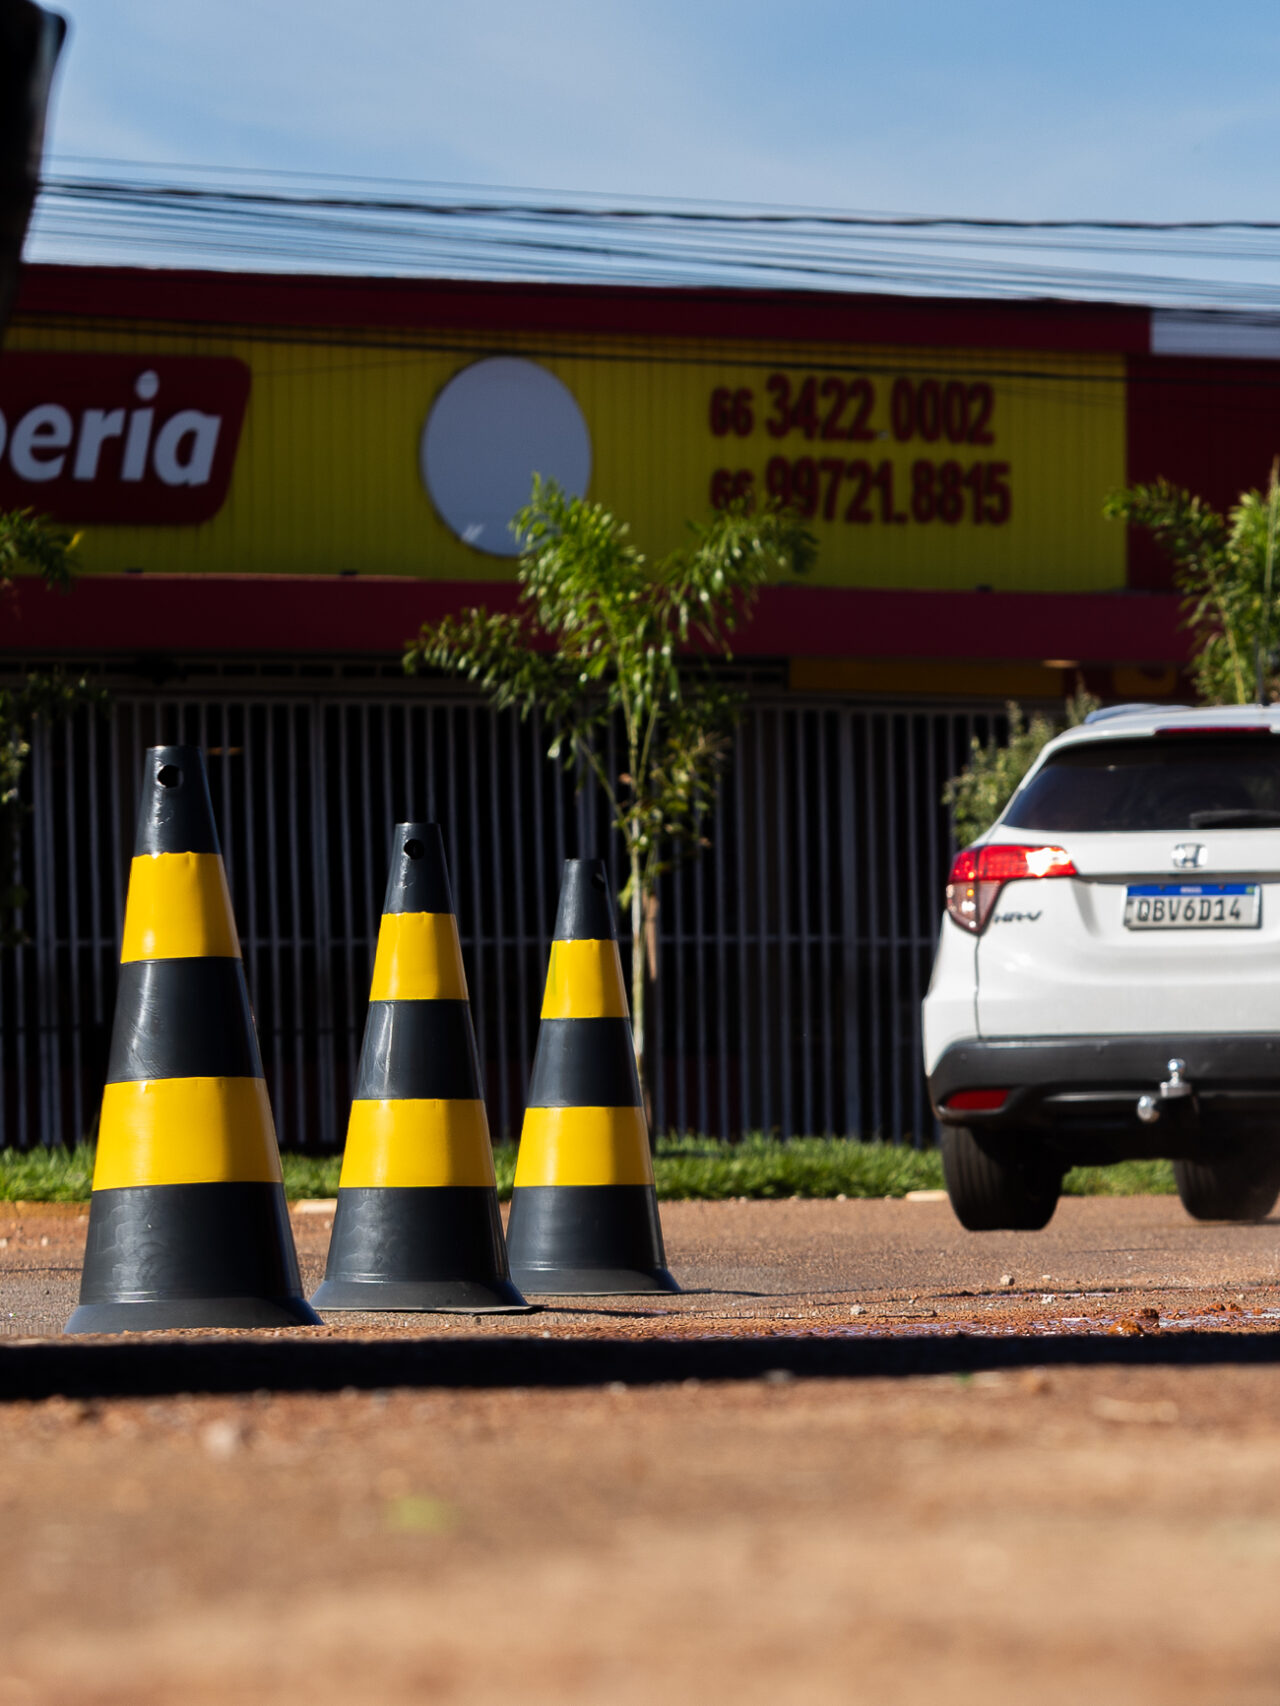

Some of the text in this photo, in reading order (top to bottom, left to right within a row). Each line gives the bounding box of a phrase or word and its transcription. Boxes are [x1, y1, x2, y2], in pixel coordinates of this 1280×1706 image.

[0, 368, 223, 488] eria
[710, 373, 995, 445] 66 3422.0002
[766, 456, 1012, 525] 99721.8815
[1137, 898, 1241, 922] QBV6D14
